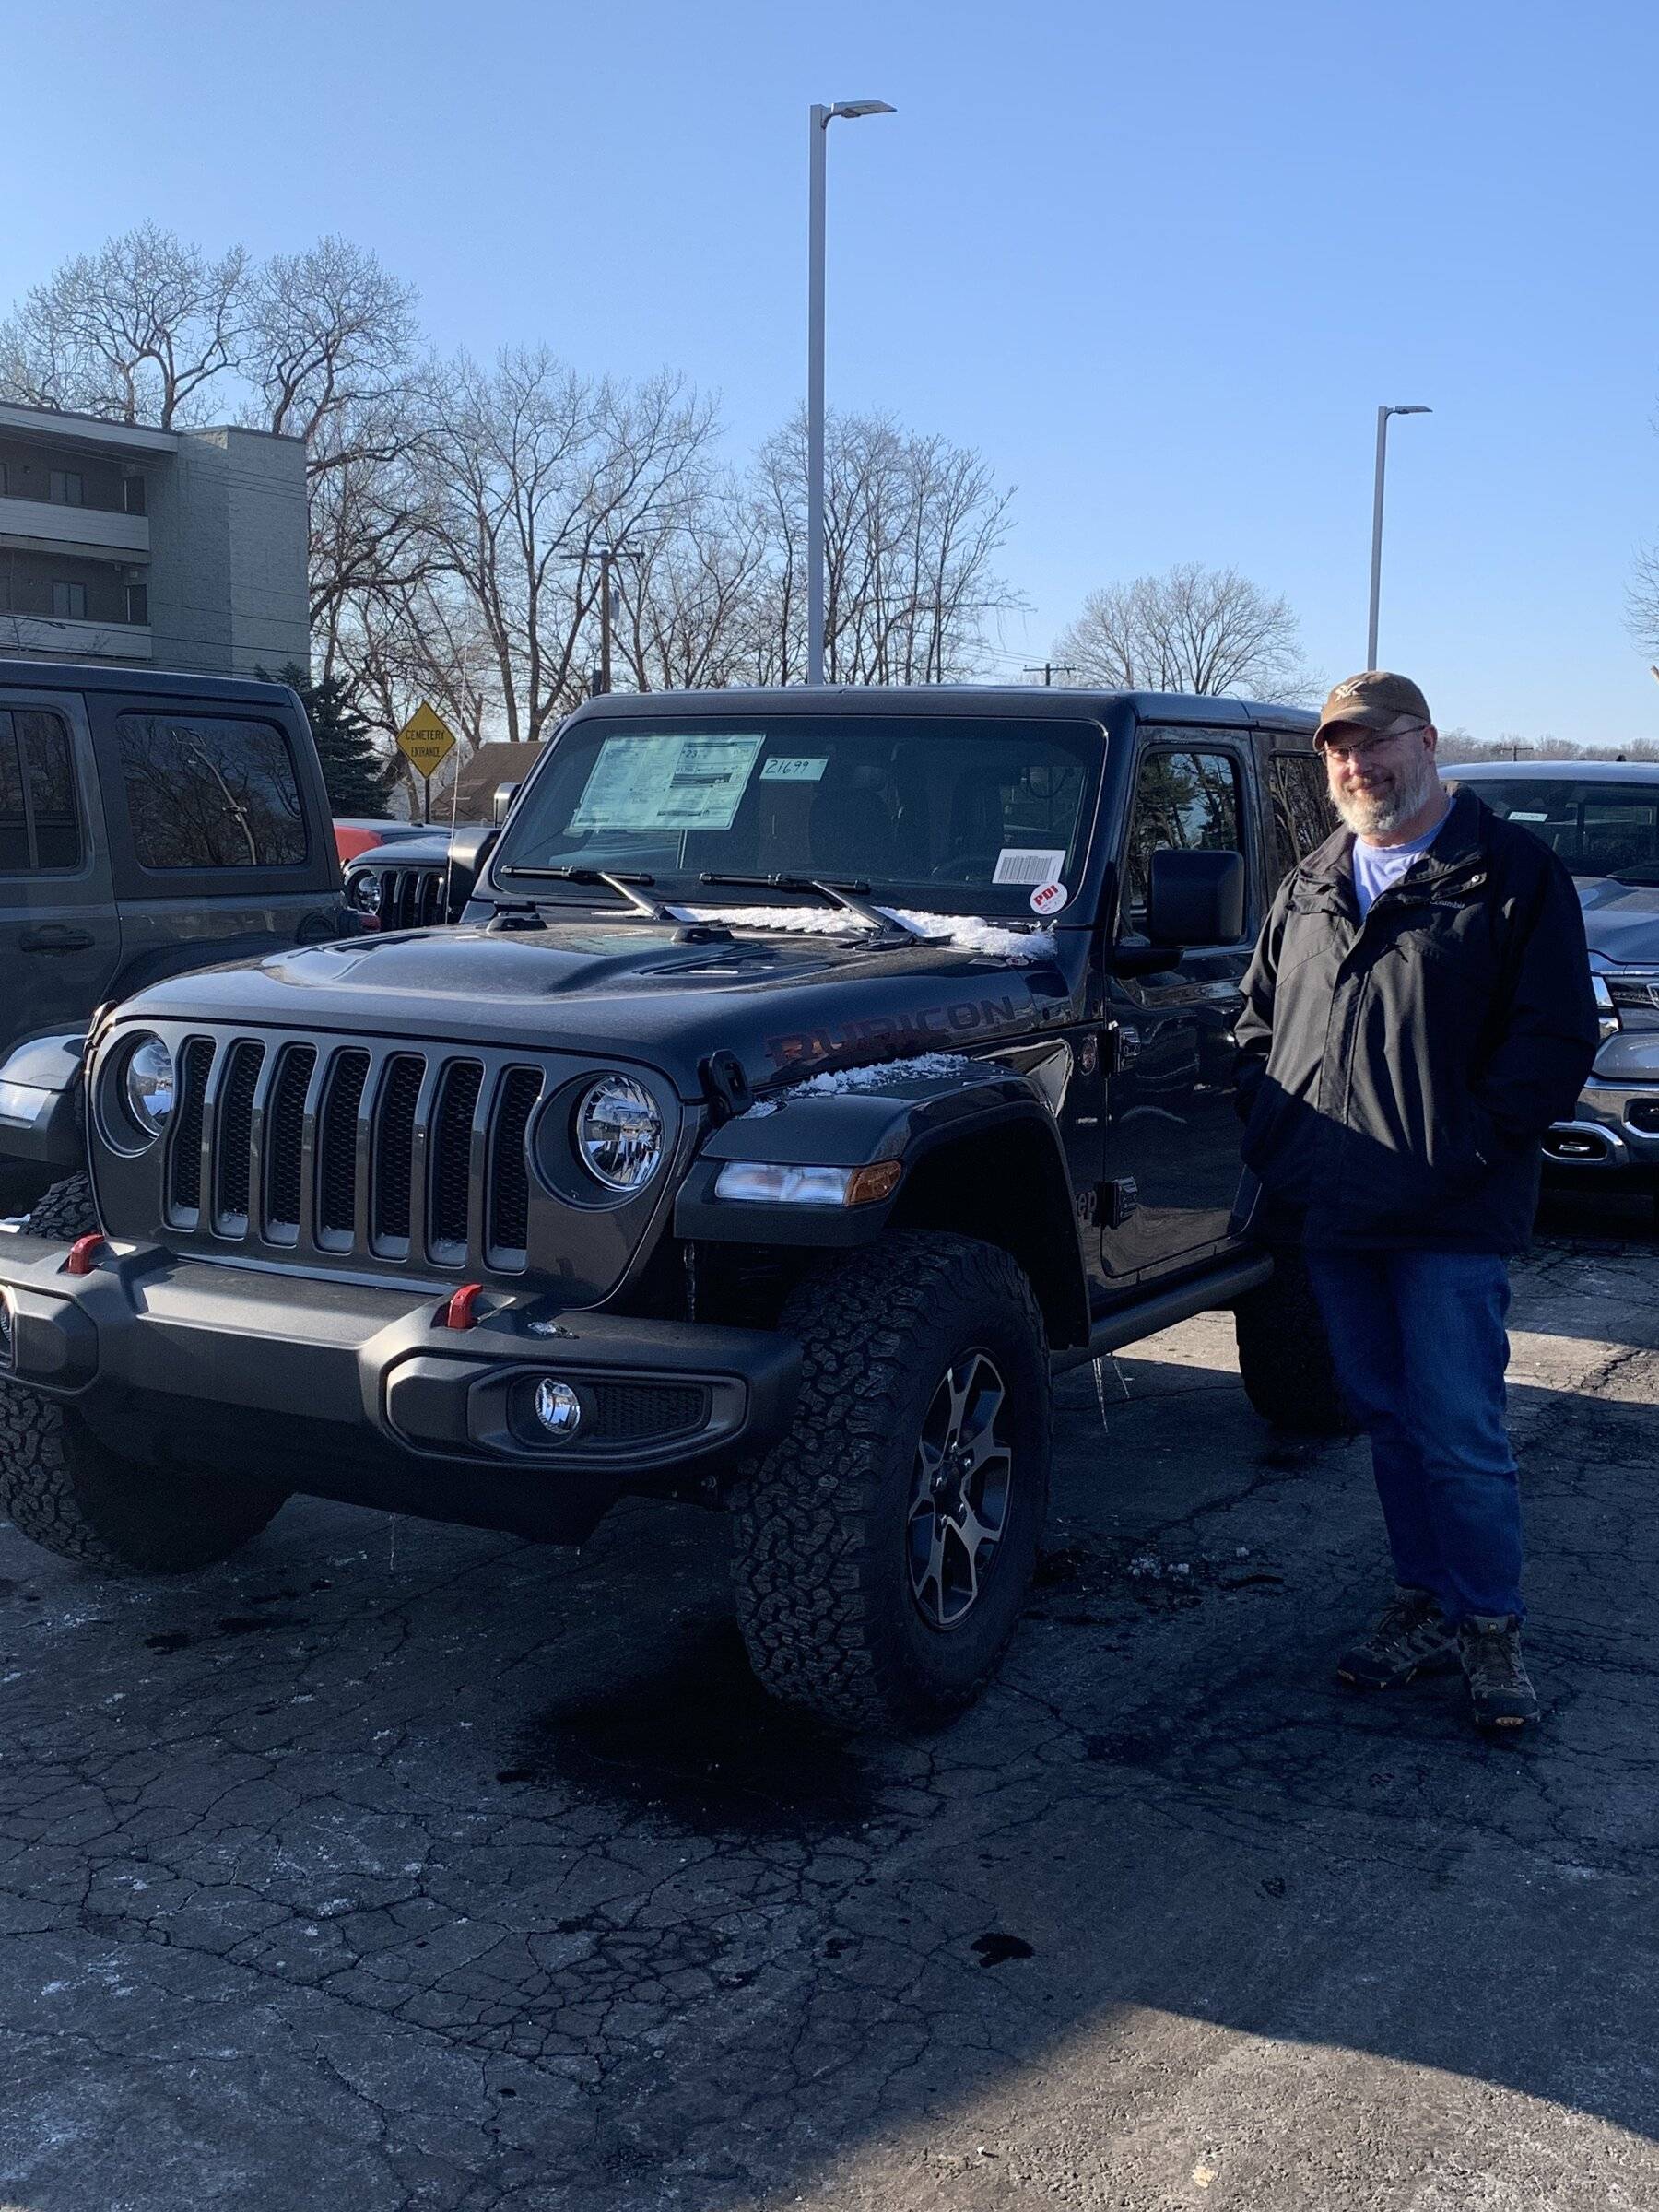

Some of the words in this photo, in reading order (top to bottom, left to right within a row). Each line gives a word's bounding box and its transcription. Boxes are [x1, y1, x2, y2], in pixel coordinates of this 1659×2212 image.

[406, 729, 444, 740] CEMETERY
[411, 746, 441, 757] ENTRANCE
[765, 759, 809, 774] 21699
[1033, 884, 1059, 906] PDI
[766, 995, 1016, 1067] RUBICON
